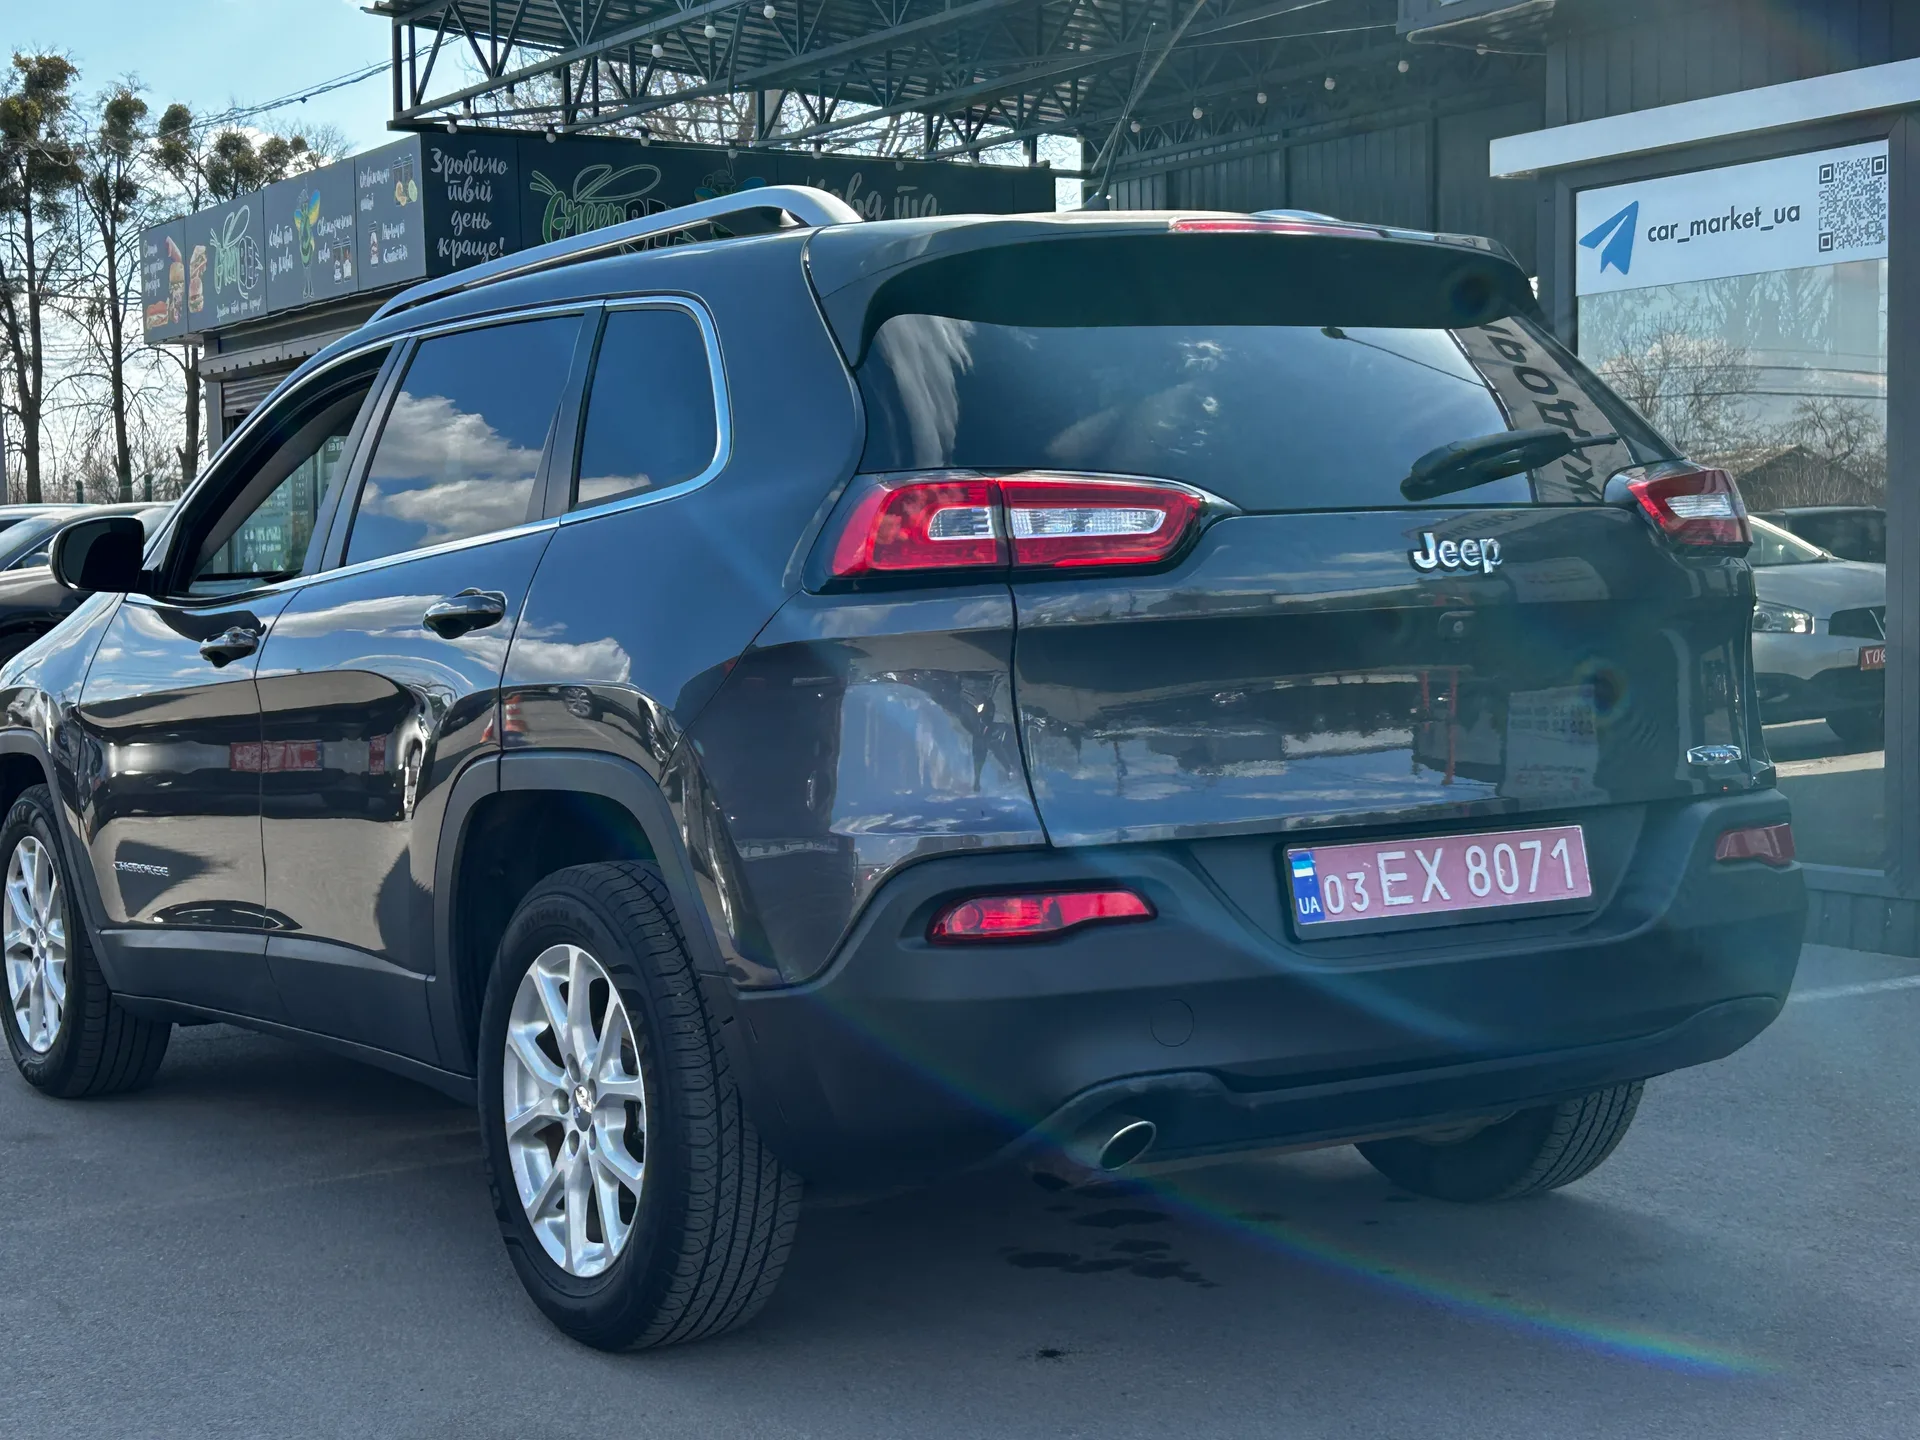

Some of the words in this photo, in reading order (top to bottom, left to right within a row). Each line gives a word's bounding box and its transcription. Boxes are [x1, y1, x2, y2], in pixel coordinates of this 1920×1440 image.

[430, 147, 508, 183] Зробимо
[447, 175, 494, 203] твій
[450, 210, 493, 237] день
[1647, 204, 1802, 244] car_market_ua
[436, 237, 505, 267] краще!
[1409, 532, 1504, 574] Jeep
[1323, 871, 1370, 915] 03
[1376, 847, 1451, 907] EX
[1464, 838, 1574, 897] 8071
[1299, 896, 1321, 915] UA
